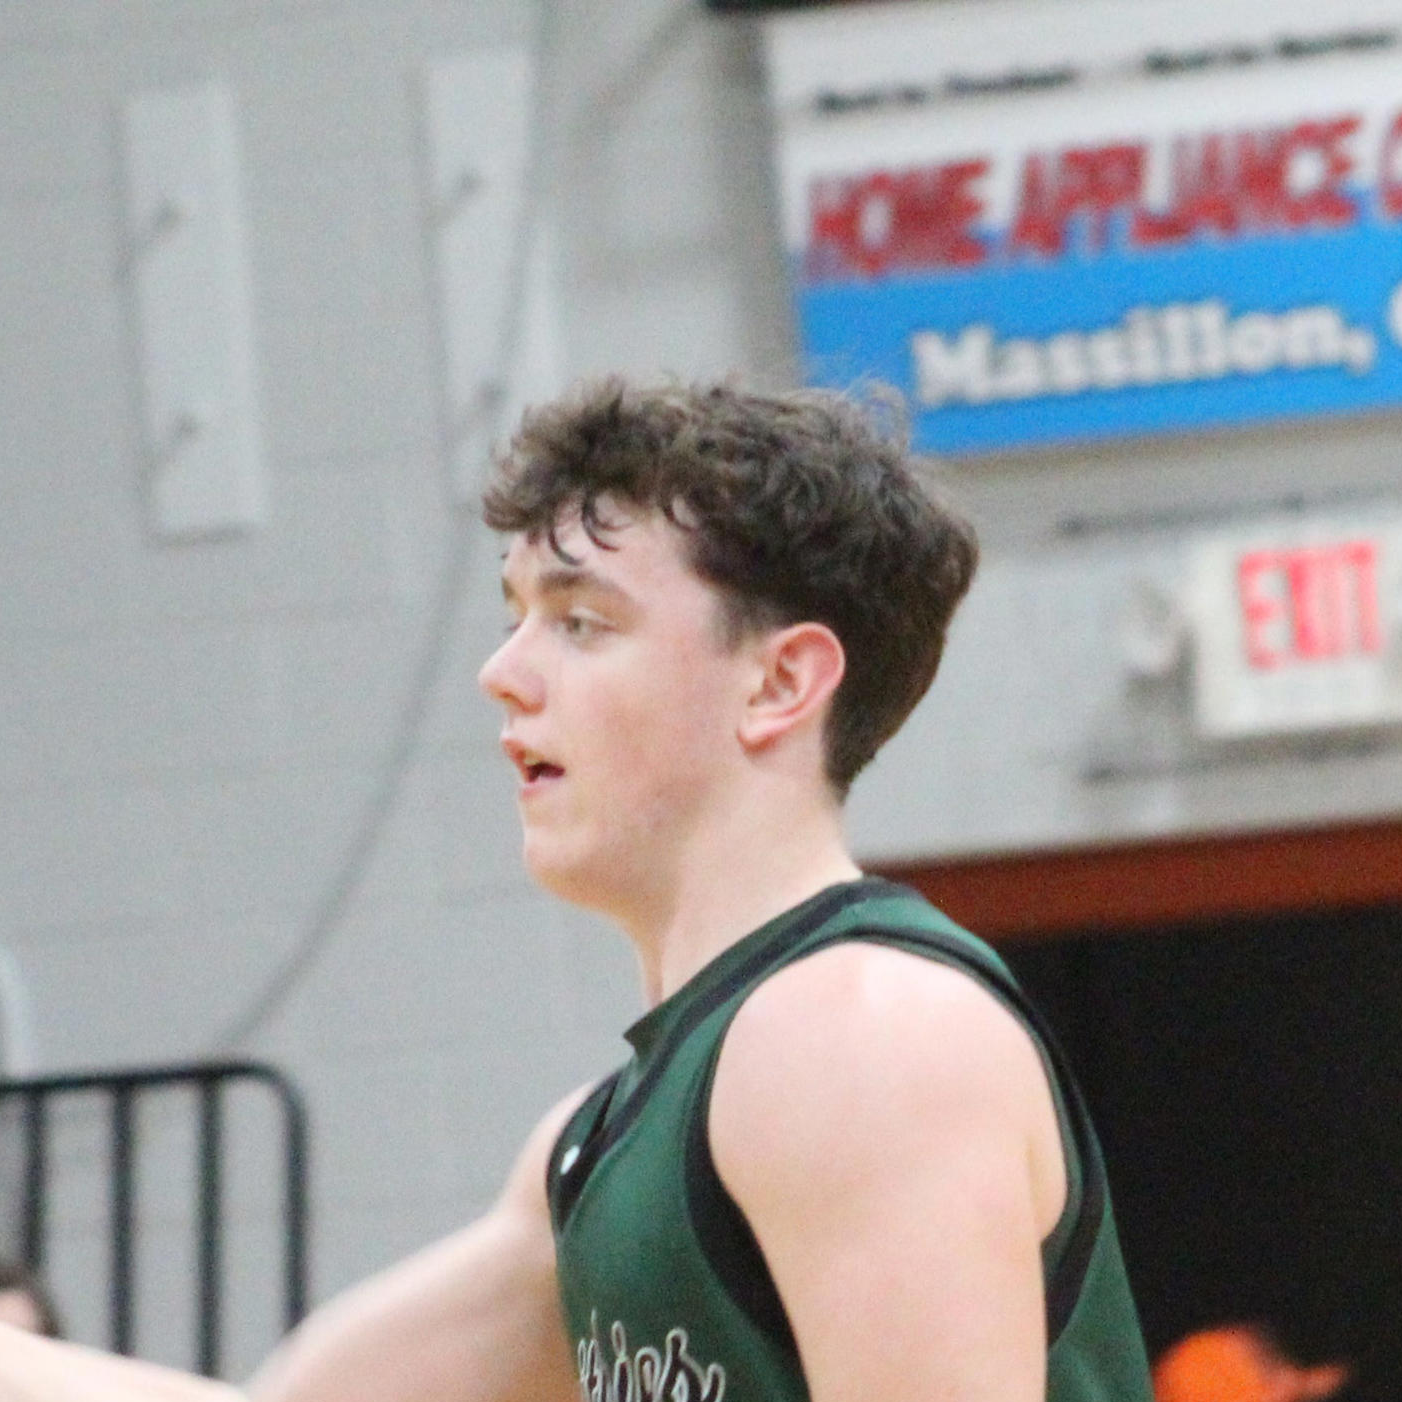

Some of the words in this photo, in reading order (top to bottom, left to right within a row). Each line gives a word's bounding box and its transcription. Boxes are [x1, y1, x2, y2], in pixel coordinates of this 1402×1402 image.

[806, 161, 990, 278] HOME
[1012, 120, 1362, 258] APPLIANCE
[910, 299, 1374, 401] Massillon,
[1238, 539, 1380, 671] EXIT
